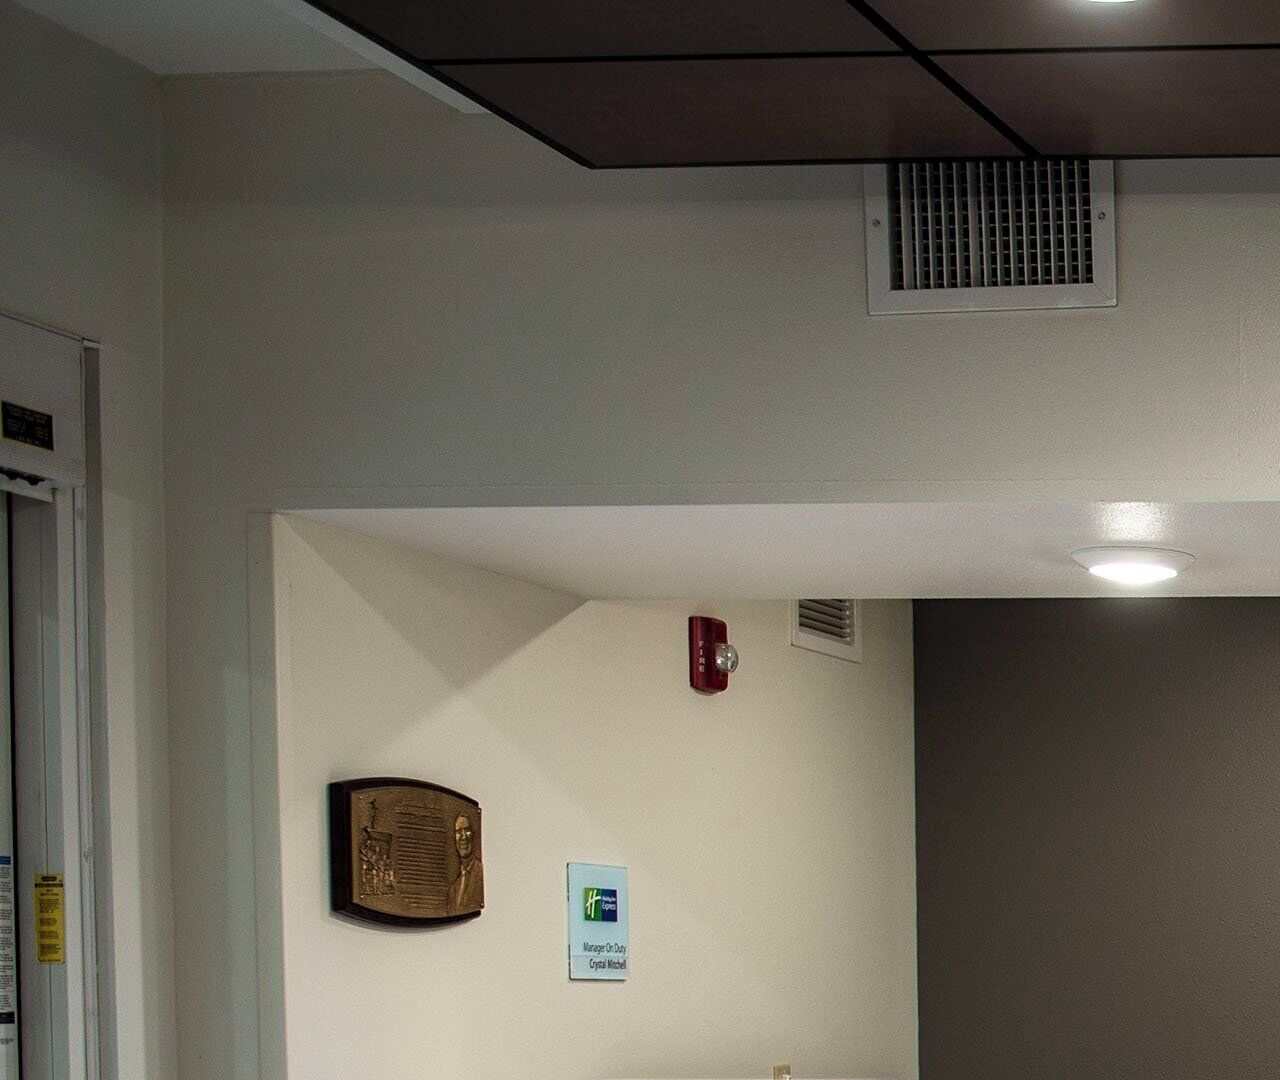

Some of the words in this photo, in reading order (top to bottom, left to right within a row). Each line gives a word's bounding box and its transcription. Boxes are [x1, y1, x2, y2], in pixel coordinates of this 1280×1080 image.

[583, 942, 605, 955] Manager
[606, 942, 613, 953] On
[614, 942, 627, 955] Duty
[589, 958, 606, 971] Crystal
